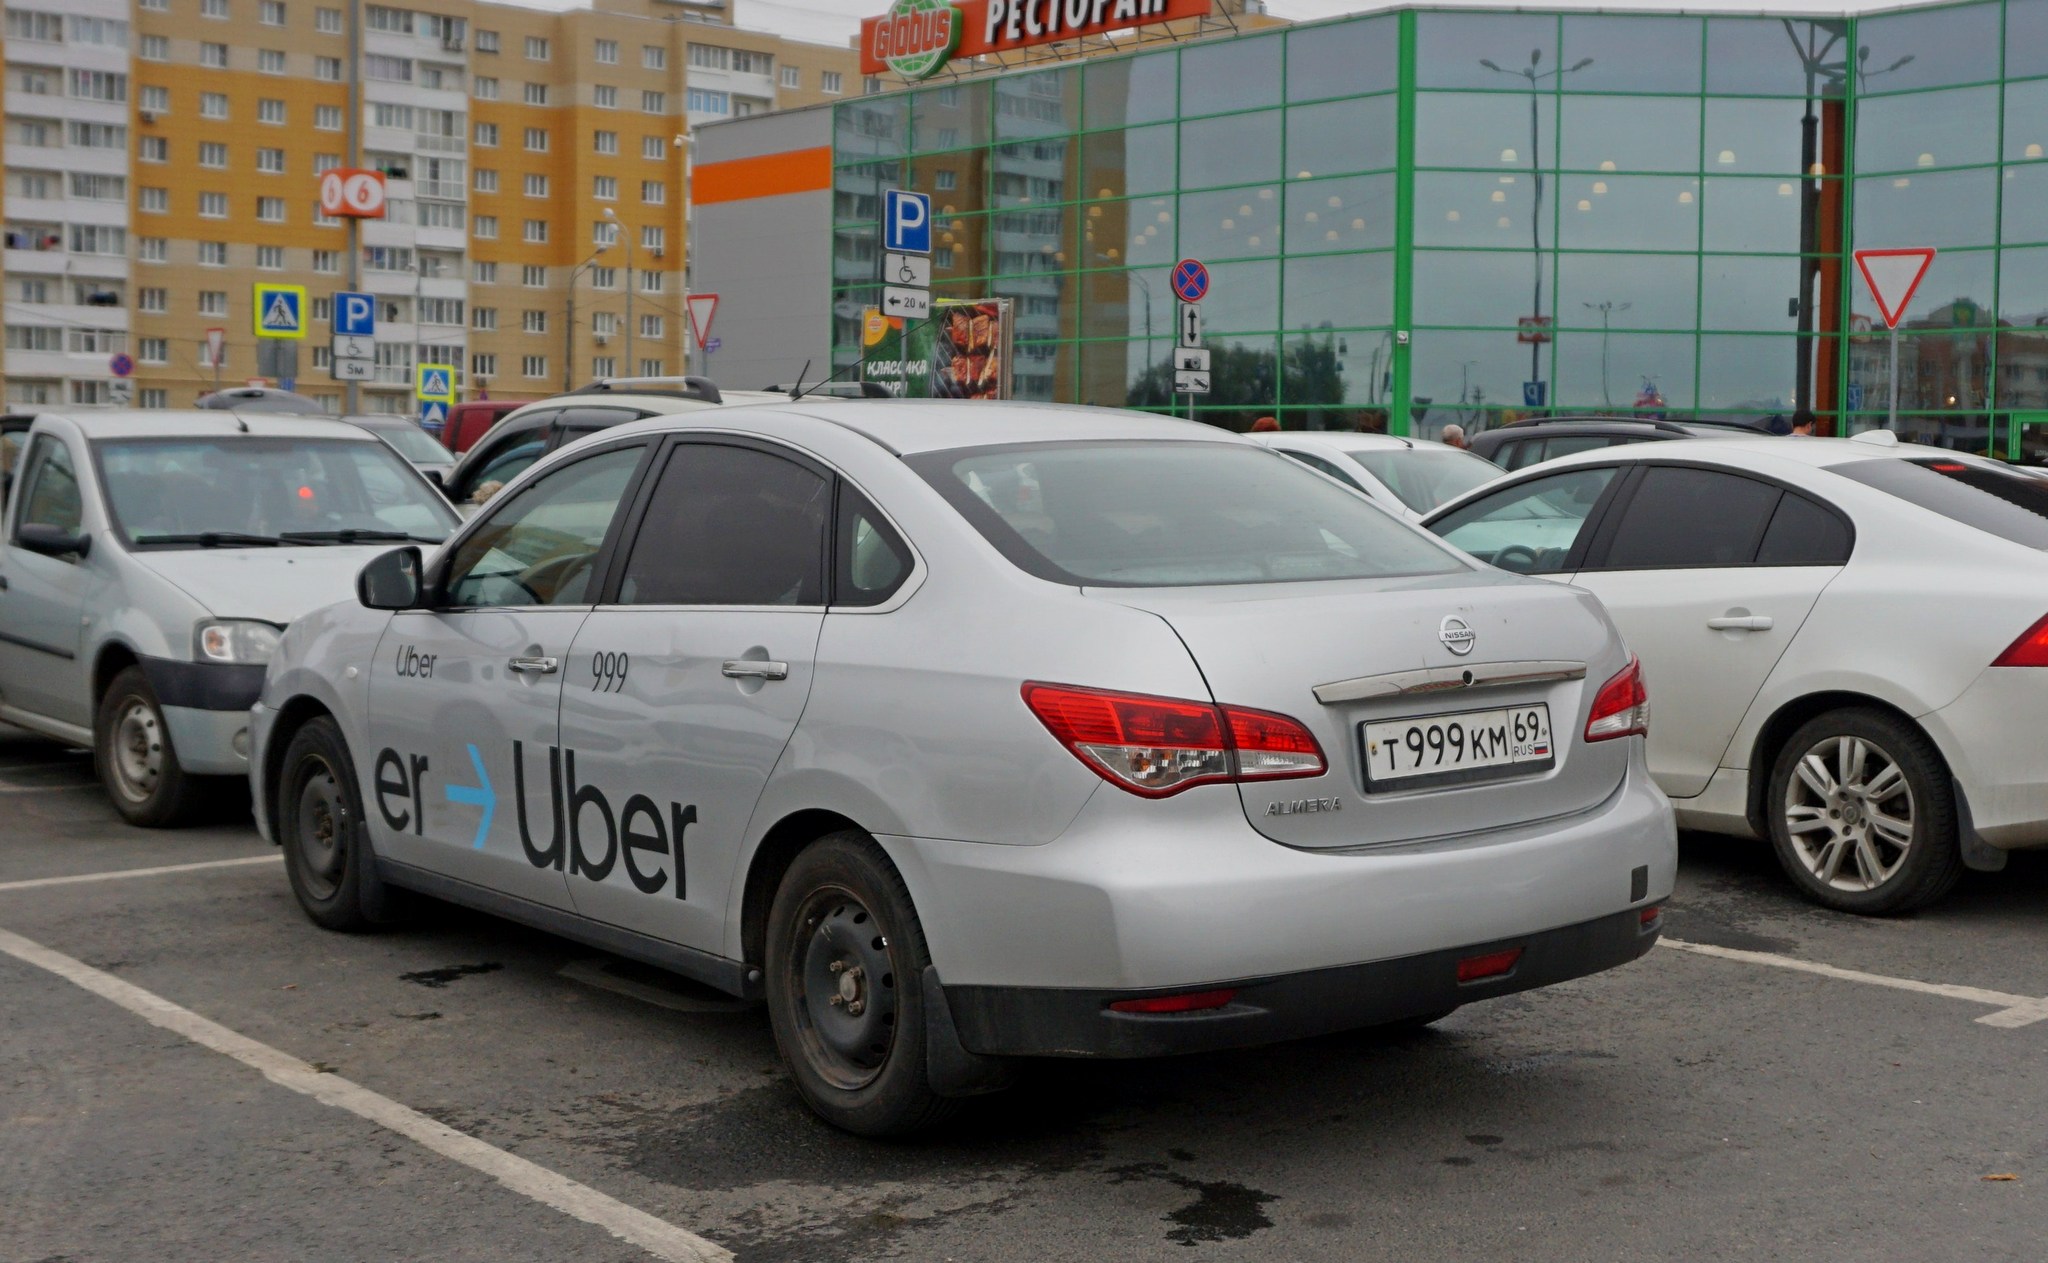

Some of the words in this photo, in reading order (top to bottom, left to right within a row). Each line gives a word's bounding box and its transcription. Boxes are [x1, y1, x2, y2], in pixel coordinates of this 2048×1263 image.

[875, 6, 951, 59] Globus
[357, 180, 369, 203] 6
[896, 193, 925, 245] P
[347, 297, 369, 331] P
[904, 297, 915, 308] 20
[1445, 630, 1474, 639] NISSAN
[396, 644, 437, 678] Uber
[592, 651, 629, 693] 999
[1514, 711, 1540, 742] 69
[1514, 744, 1534, 757] RUS
[375, 747, 429, 836] er
[513, 740, 698, 901] Uber
[1264, 797, 1342, 816] ALMERA
